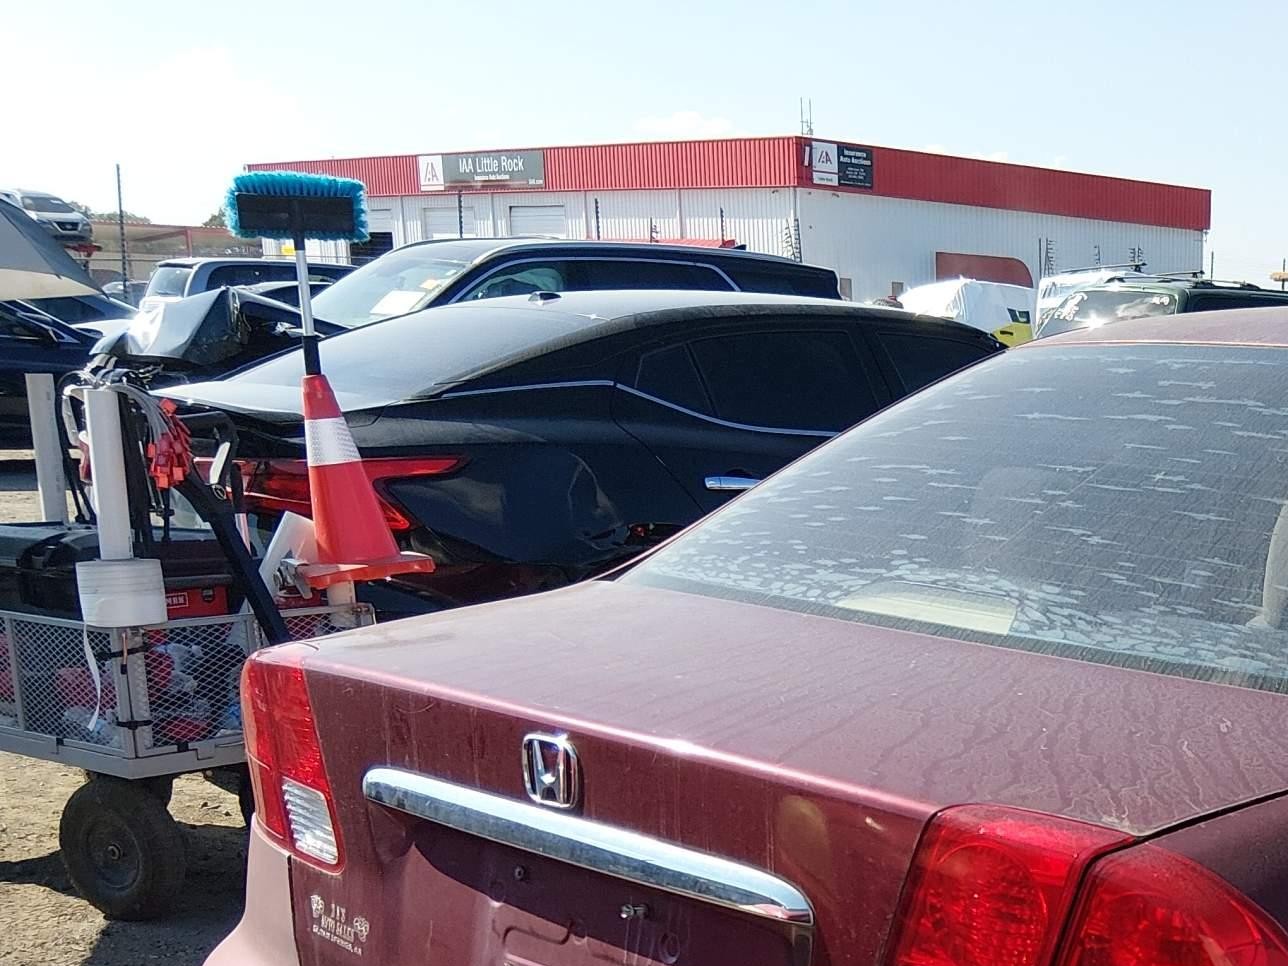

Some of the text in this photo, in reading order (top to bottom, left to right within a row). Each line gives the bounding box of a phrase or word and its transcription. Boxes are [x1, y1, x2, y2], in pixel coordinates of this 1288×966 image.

[459, 155, 525, 173] IAA Little Rock
